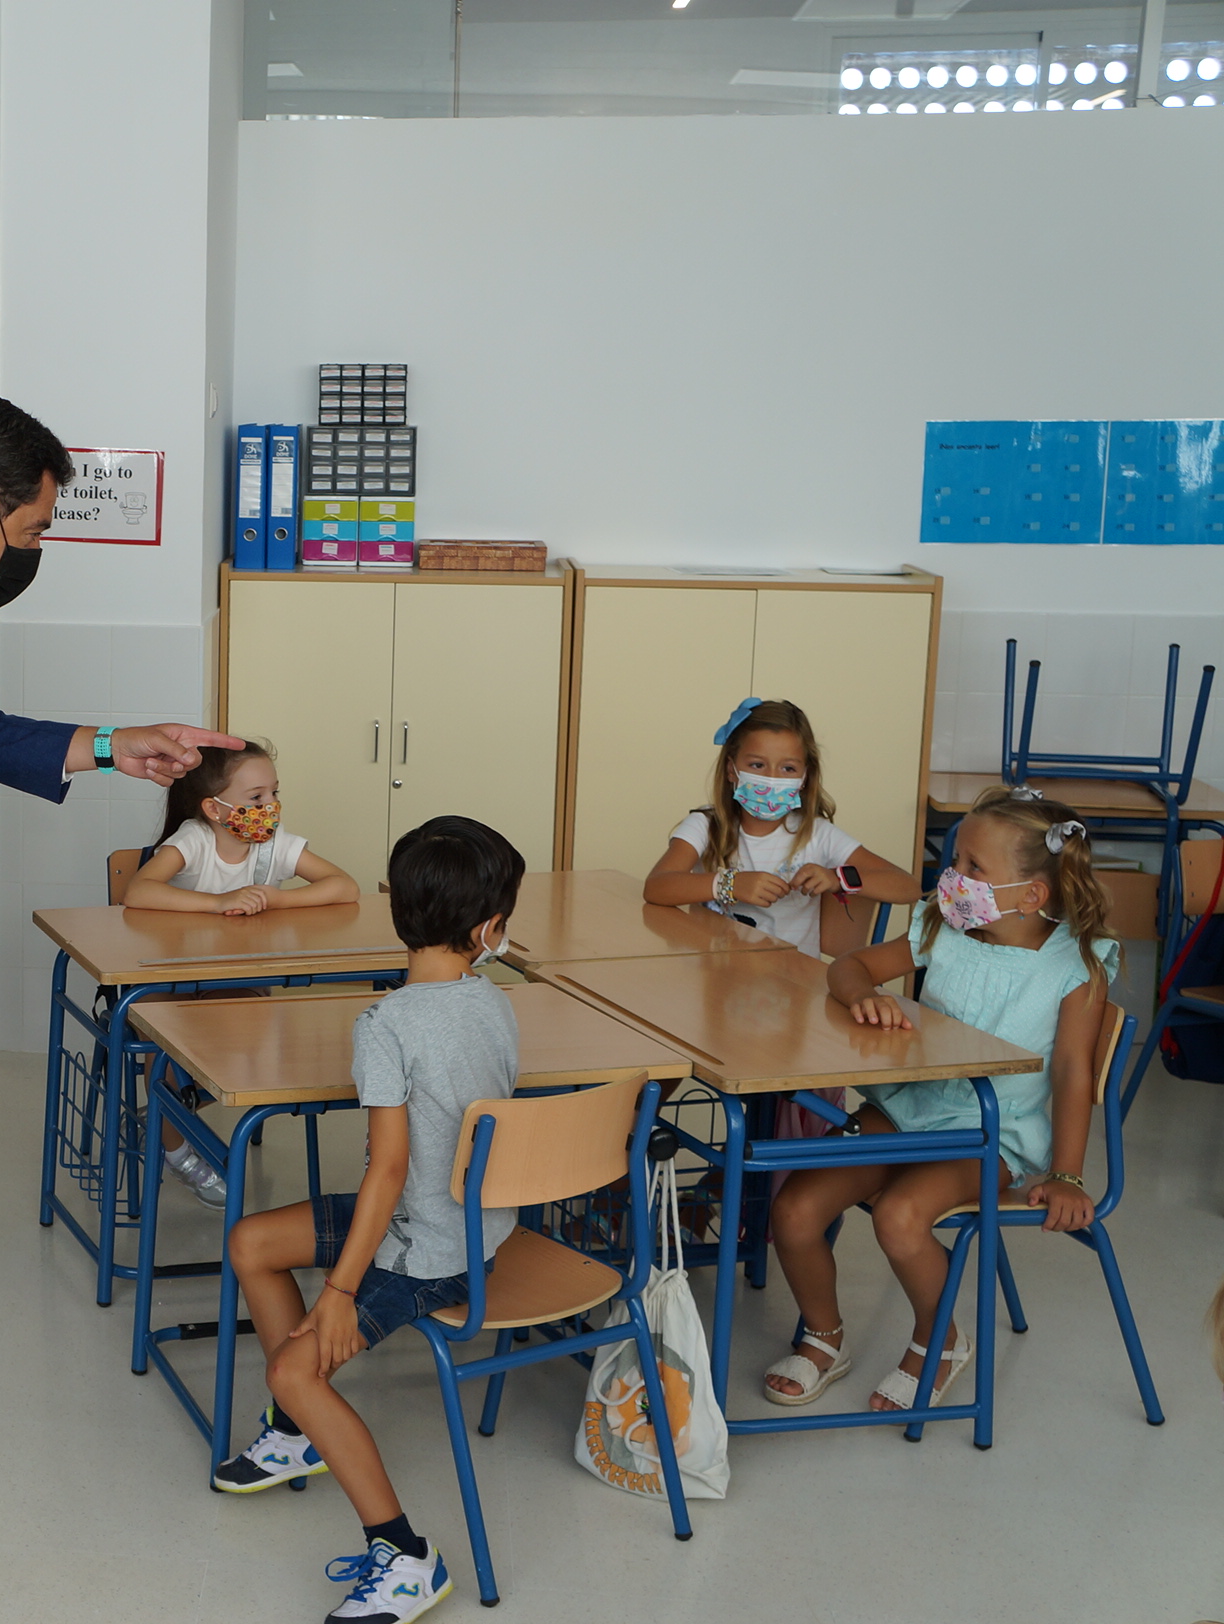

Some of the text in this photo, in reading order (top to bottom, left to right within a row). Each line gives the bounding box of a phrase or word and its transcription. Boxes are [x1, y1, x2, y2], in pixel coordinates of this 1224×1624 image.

[83, 464, 88, 477] I
[94, 467, 112, 481] go
[118, 466, 133, 479] to
[73, 486, 118, 503] toilet,
[54, 506, 100, 521] lease?
